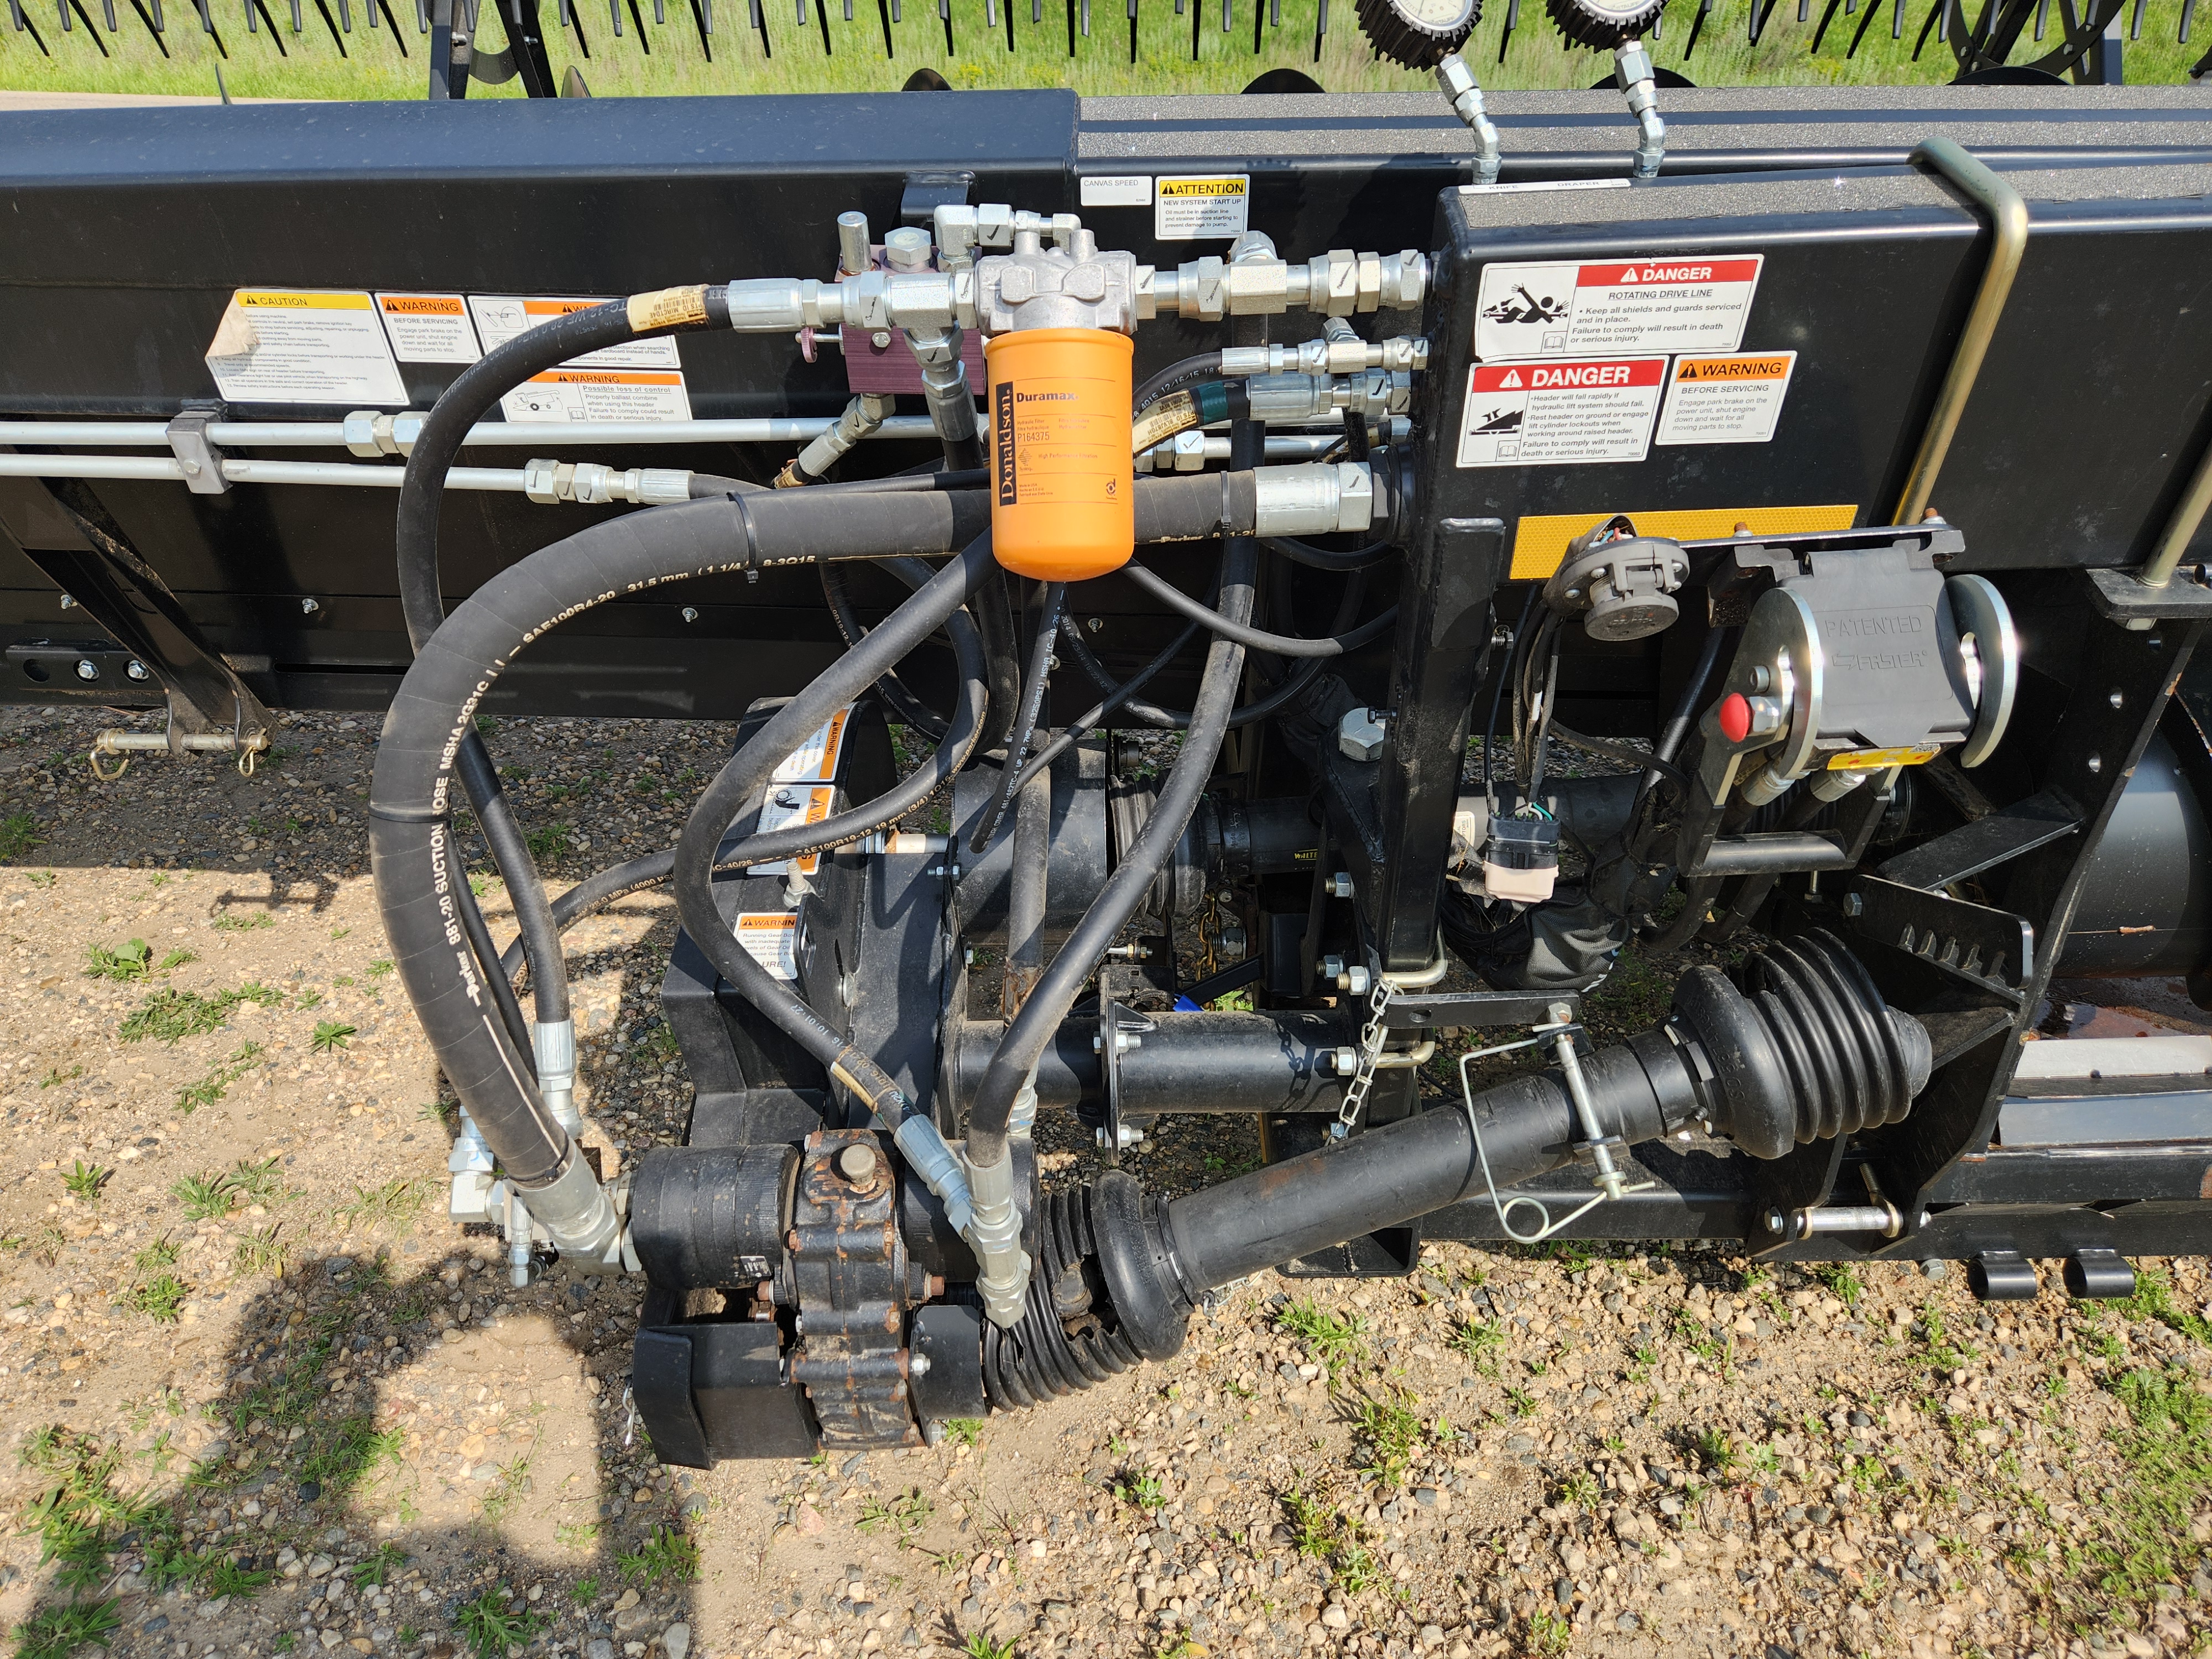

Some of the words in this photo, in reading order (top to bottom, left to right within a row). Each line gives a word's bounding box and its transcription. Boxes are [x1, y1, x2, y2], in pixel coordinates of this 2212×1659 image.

[1176, 184, 1244, 195] ATTENTION
[1642, 267, 1712, 282] DANGER
[260, 297, 307, 306] CAUTION
[1608, 291, 1657, 300] ROTATING
[1660, 290, 1689, 299] DRIVE
[399, 301, 458, 312] WARNING
[1673, 304, 1703, 313] guards
[570, 374, 620, 383] WARNING
[1531, 366, 1631, 387] DANGER
[1702, 362, 1782, 377] WARNING
[1586, 411, 1611, 420] ground
[1018, 431, 1050, 442] P164375
[523, 590, 615, 643] SAE100R4-20
[627, 577, 657, 592] 31.5
[661, 572, 689, 583] mm
[763, 555, 816, 566] 8-3Q15
[1825, 615, 1923, 637] PATENTED
[457, 681, 489, 724] 2G31C
[439, 726, 465, 770] MSHA
[827, 726, 840, 755] WARNING
[874, 822, 887, 831] 19
[889, 811, 907, 825] mm
[908, 795, 929, 814] (3/4)
[430, 822, 448, 895] SUCTION
[439, 895, 461, 946] 881-20
[457, 950, 481, 1007] Parker
